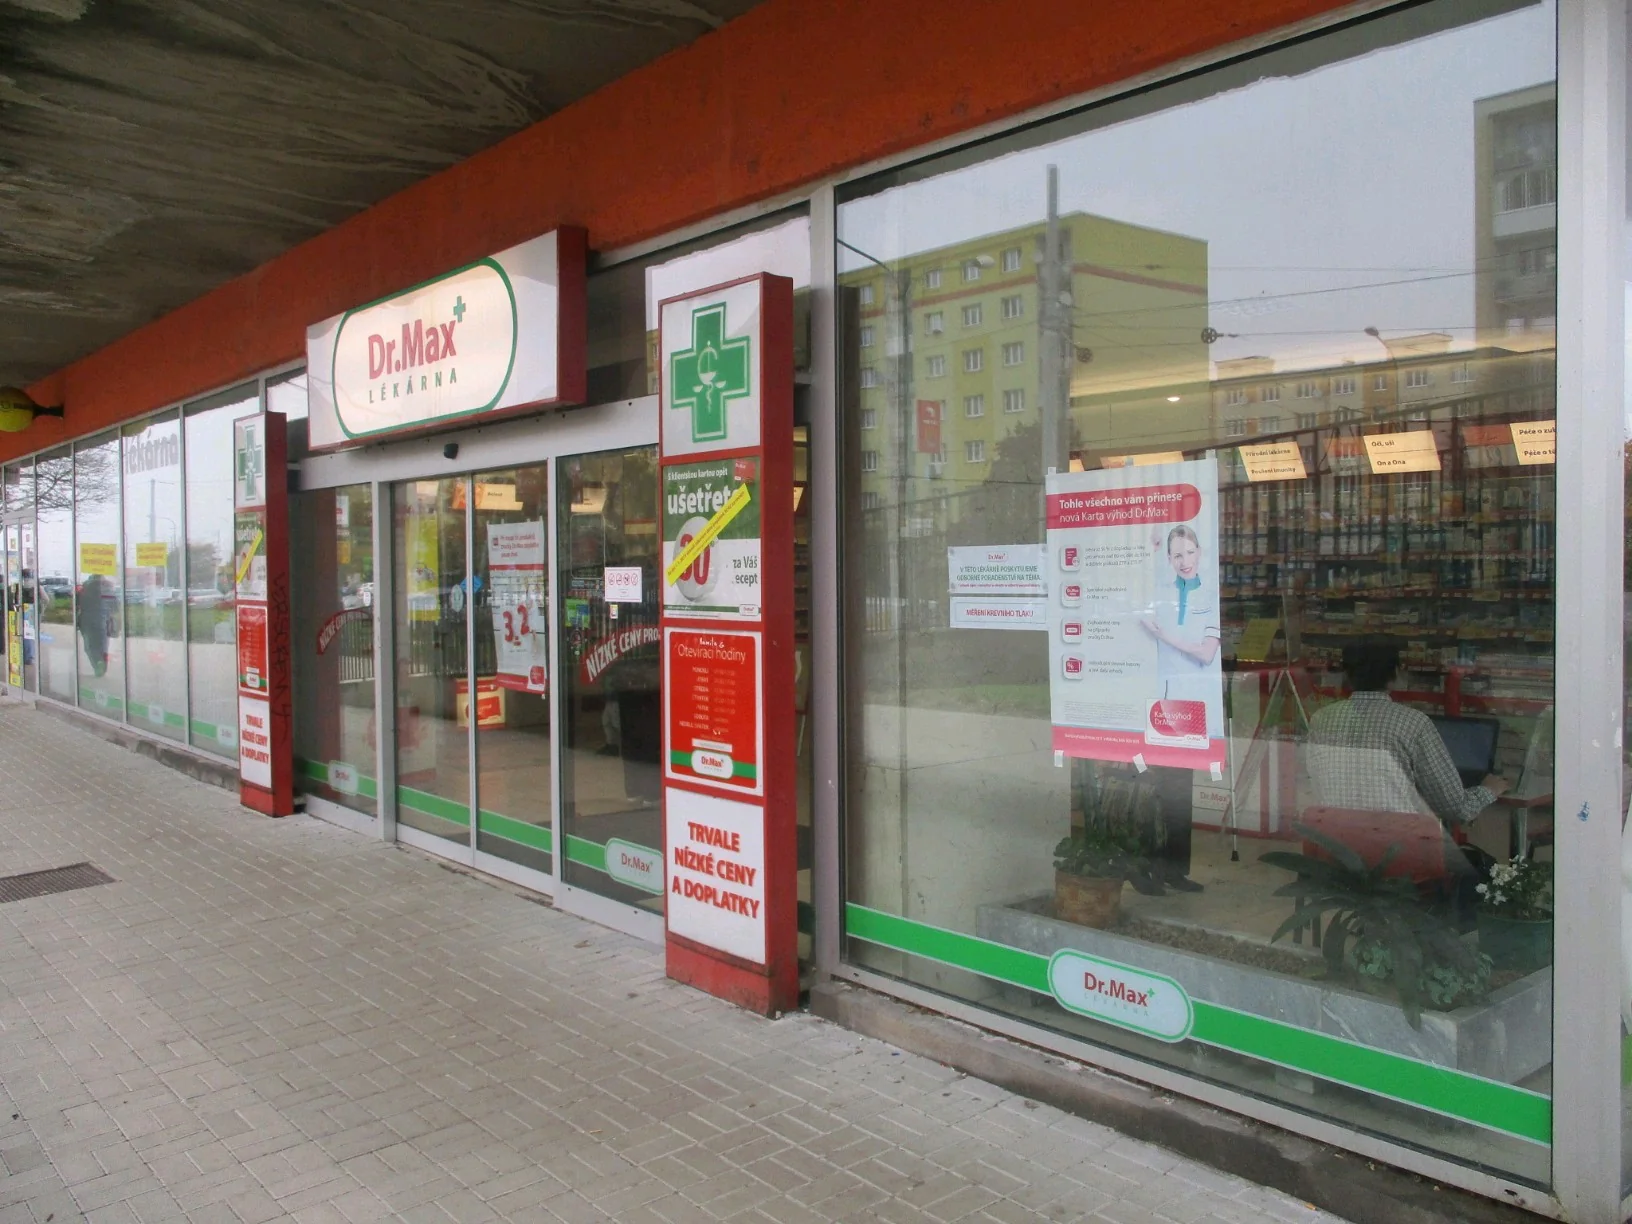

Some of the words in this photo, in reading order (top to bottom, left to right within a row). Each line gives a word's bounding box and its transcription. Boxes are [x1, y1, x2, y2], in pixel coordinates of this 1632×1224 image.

[368, 319, 457, 380] Dr.Max
[369, 367, 458, 404] LÉKÁRNA
[1059, 498, 1084, 509] Tohle
[1085, 496, 1123, 508] všechno
[1124, 494, 1145, 505] vám
[1146, 493, 1183, 506] přinese
[1059, 511, 1080, 523] nová
[1081, 510, 1105, 521] Karta
[1106, 508, 1133, 522] výhod
[733, 559, 741, 569] za
[743, 556, 758, 569] Váš
[1000, 565, 1038, 573] POSKYTUJEME
[732, 573, 758, 587] ecept
[966, 608, 986, 616] MĚŘENÍ
[987, 609, 1014, 617] KREVNÍHO
[1015, 609, 1034, 617] TLAKU
[586, 635, 618, 682] NÍZKÉ
[619, 628, 642, 653] CENY
[715, 648, 746, 664] hodiny
[1171, 711, 1192, 722] výhod
[701, 756, 722, 768] Dr.Max
[688, 821, 740, 852] TRVALE
[621, 852, 651, 873] Dr.Max
[674, 846, 714, 876] NÍZKÉ
[716, 859, 757, 887] CENY
[672, 875, 681, 895] A
[684, 879, 760, 919] DOPLATKY
[1084, 971, 1148, 1007] Dr.Max
